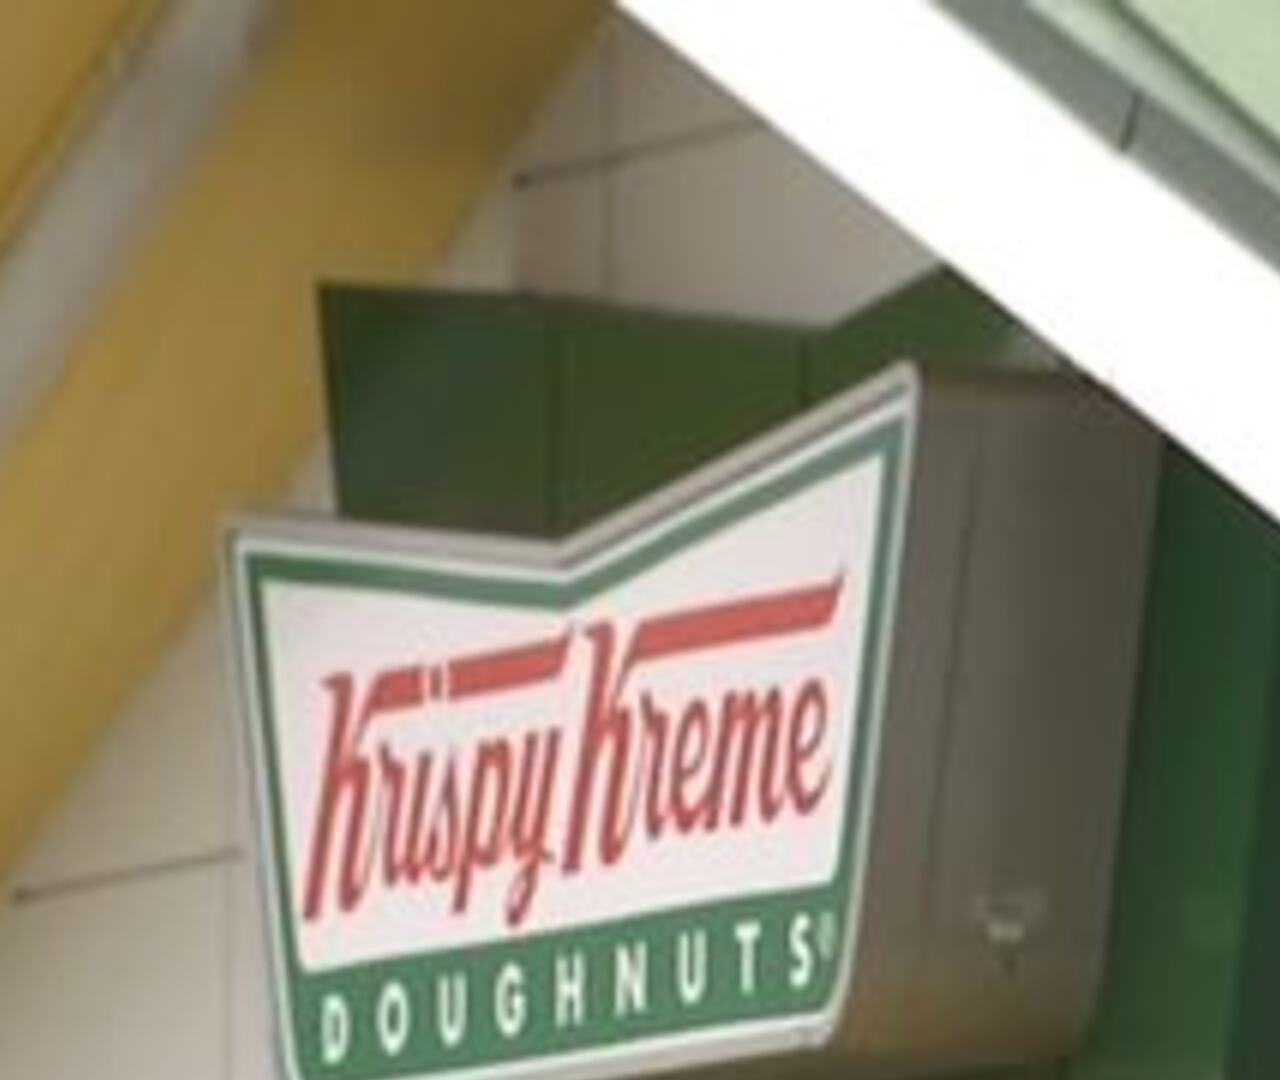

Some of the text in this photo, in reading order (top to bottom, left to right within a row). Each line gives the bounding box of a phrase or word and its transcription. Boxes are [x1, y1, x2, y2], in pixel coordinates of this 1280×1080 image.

[302, 568, 845, 927] Krispy Kreme
[321, 912, 813, 1065] DOUGHNUTS
